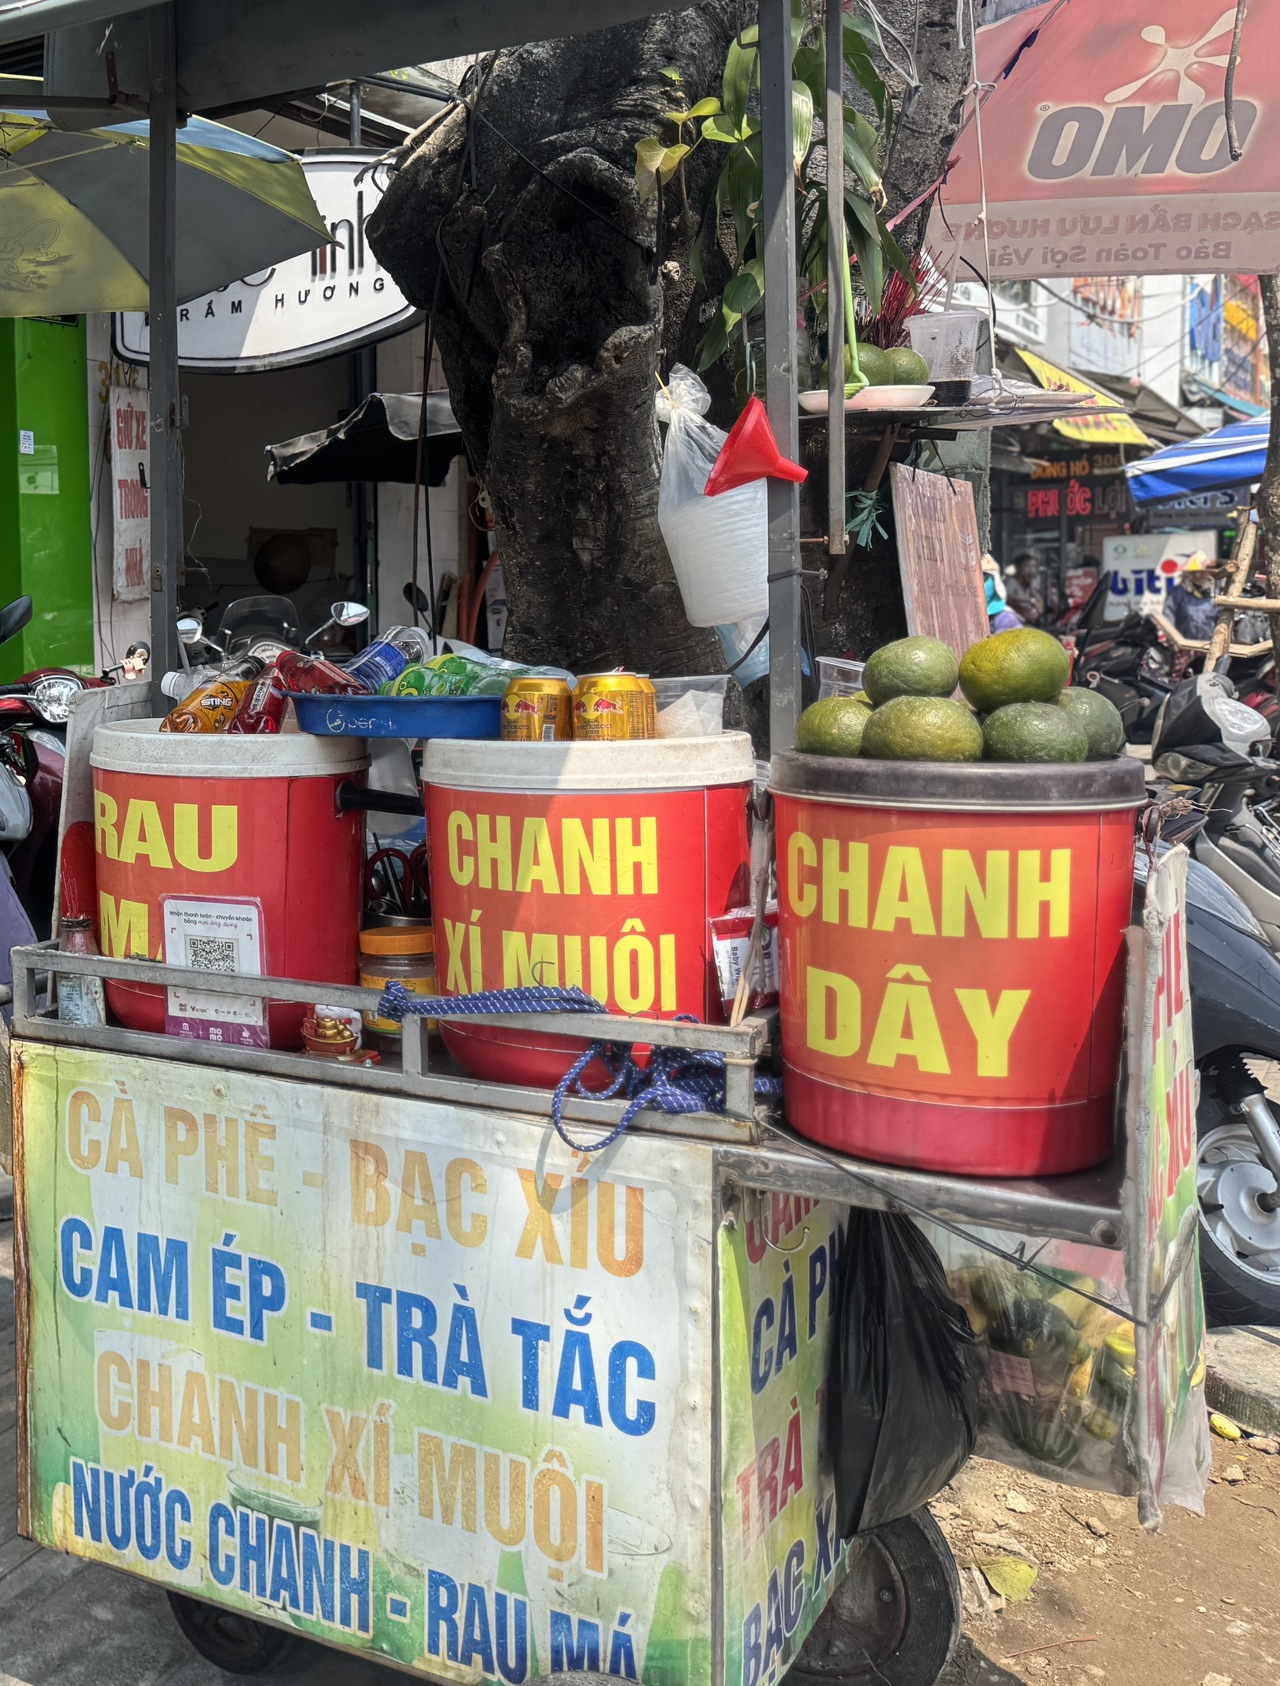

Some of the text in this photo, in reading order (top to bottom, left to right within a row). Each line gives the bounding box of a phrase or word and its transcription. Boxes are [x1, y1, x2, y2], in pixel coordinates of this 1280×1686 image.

[274, 277, 385, 311] HƯƠNG
[135, 410, 147, 451] XE
[201, 696, 233, 708] STING
[94, 788, 238, 873] RAU
[447, 810, 659, 897] CHANH
[100, 890, 163, 962] M
[787, 831, 1072, 939] CHANH
[443, 909, 483, 996] XÍ
[731, 946, 740, 969] Baby
[806, 963, 1032, 1077] DÂY
[68, 1079, 143, 1179] CÀ
[164, 1104, 278, 1207] PHÊ
[350, 1138, 488, 1257] BẠC
[61, 1217, 189, 1321] CAM
[211, 1233, 286, 1342] ÉP
[355, 1281, 488, 1399] TRÀ
[511, 1294, 656, 1437] TẮC
[750, 1224, 845, 1395] CÀ PH
[96, 1350, 604, 1582] CHANH XÍ MUỘI
[736, 1394, 804, 1560] TRÀ
[72, 1460, 192, 1571] NƯỚC
[208, 1503, 370, 1633] CHANH
[427, 1568, 527, 1685] RAU
[549, 1610, 638, 1681] MÁ
